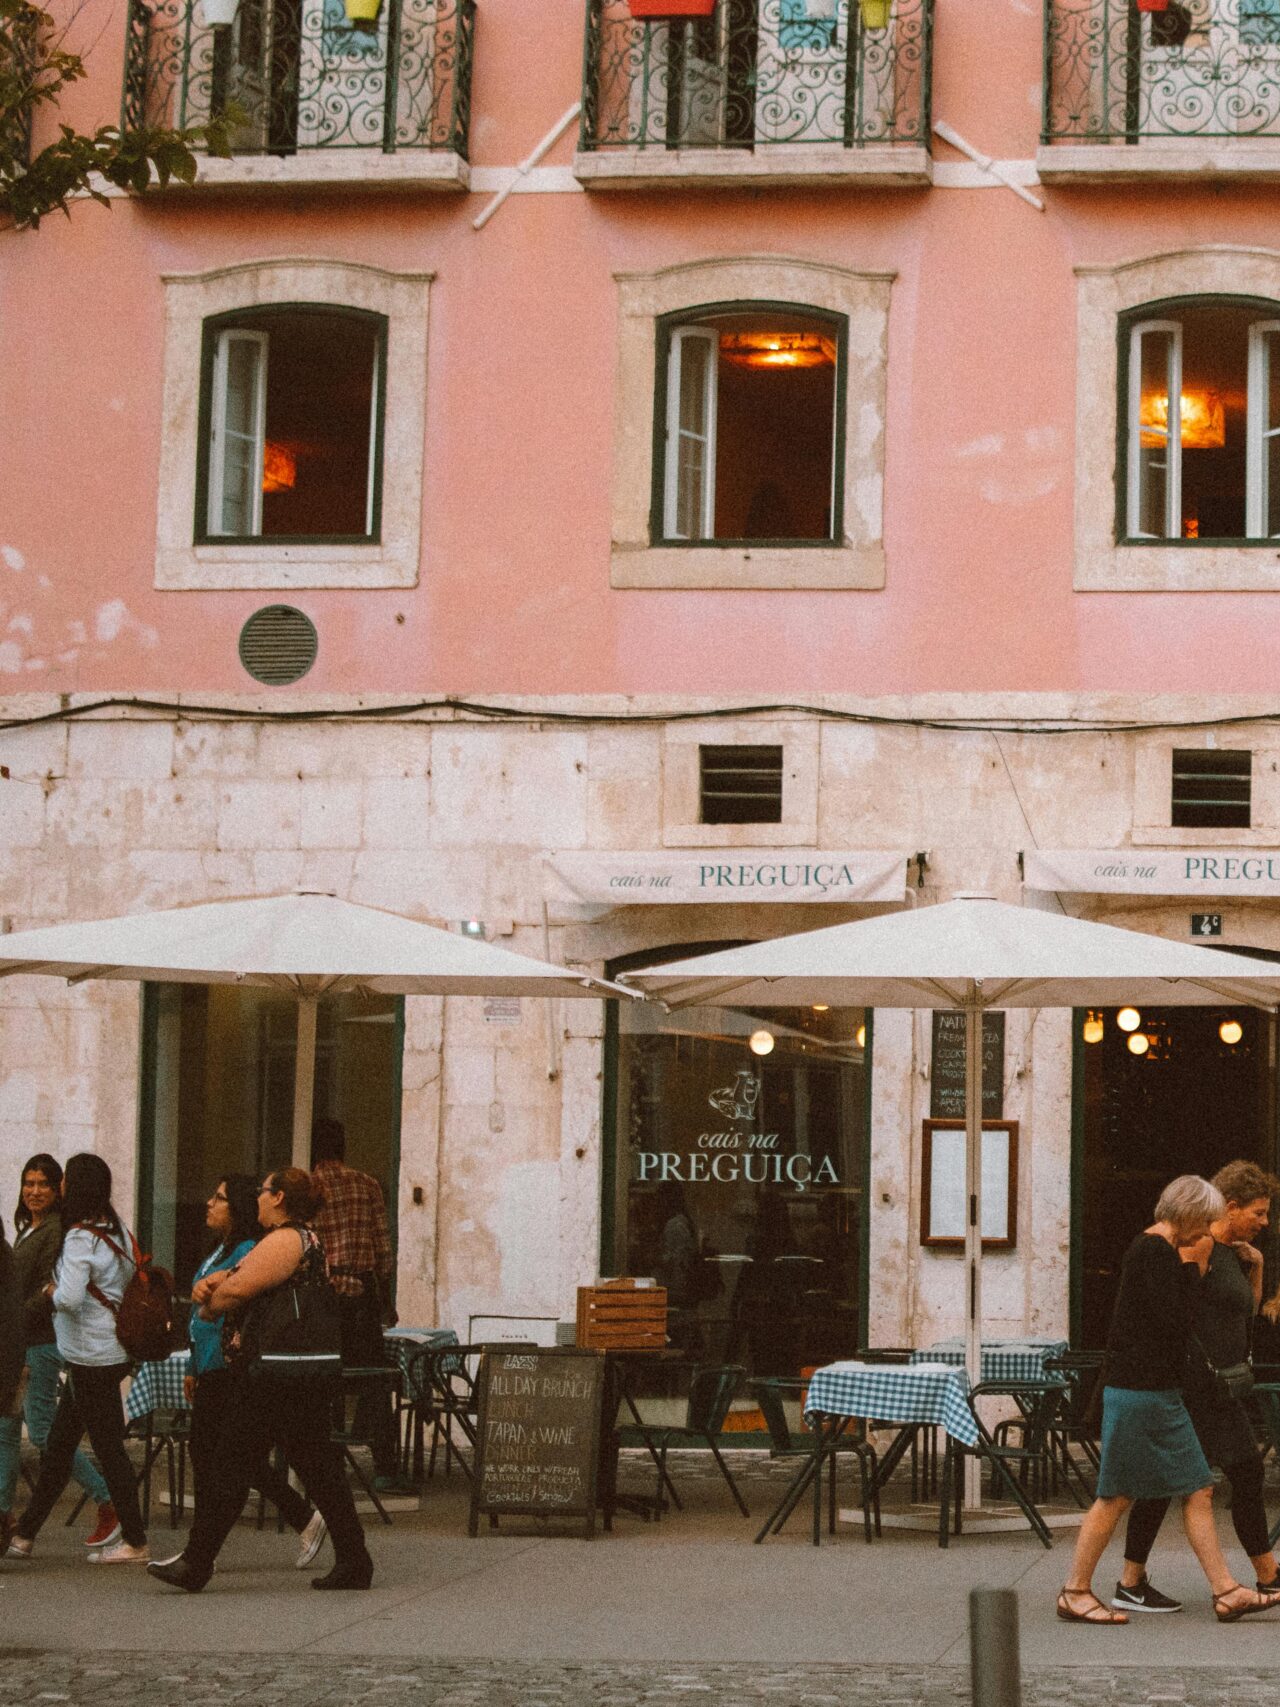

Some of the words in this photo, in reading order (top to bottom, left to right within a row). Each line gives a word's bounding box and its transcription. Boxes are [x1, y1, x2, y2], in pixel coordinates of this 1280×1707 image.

[609, 872, 643, 888] cais
[649, 874, 672, 887] na
[700, 864, 854, 892] PREGUIÇA
[1094, 860, 1127, 878] cais
[1134, 866, 1157, 879] na
[698, 1127, 743, 1149] cais
[749, 1131, 779, 1149] na
[637, 1152, 840, 1192] PREGUIÇA
[490, 1375, 512, 1396] ALL
[514, 1375, 537, 1397] DAY
[542, 1377, 593, 1400] BRUNCH
